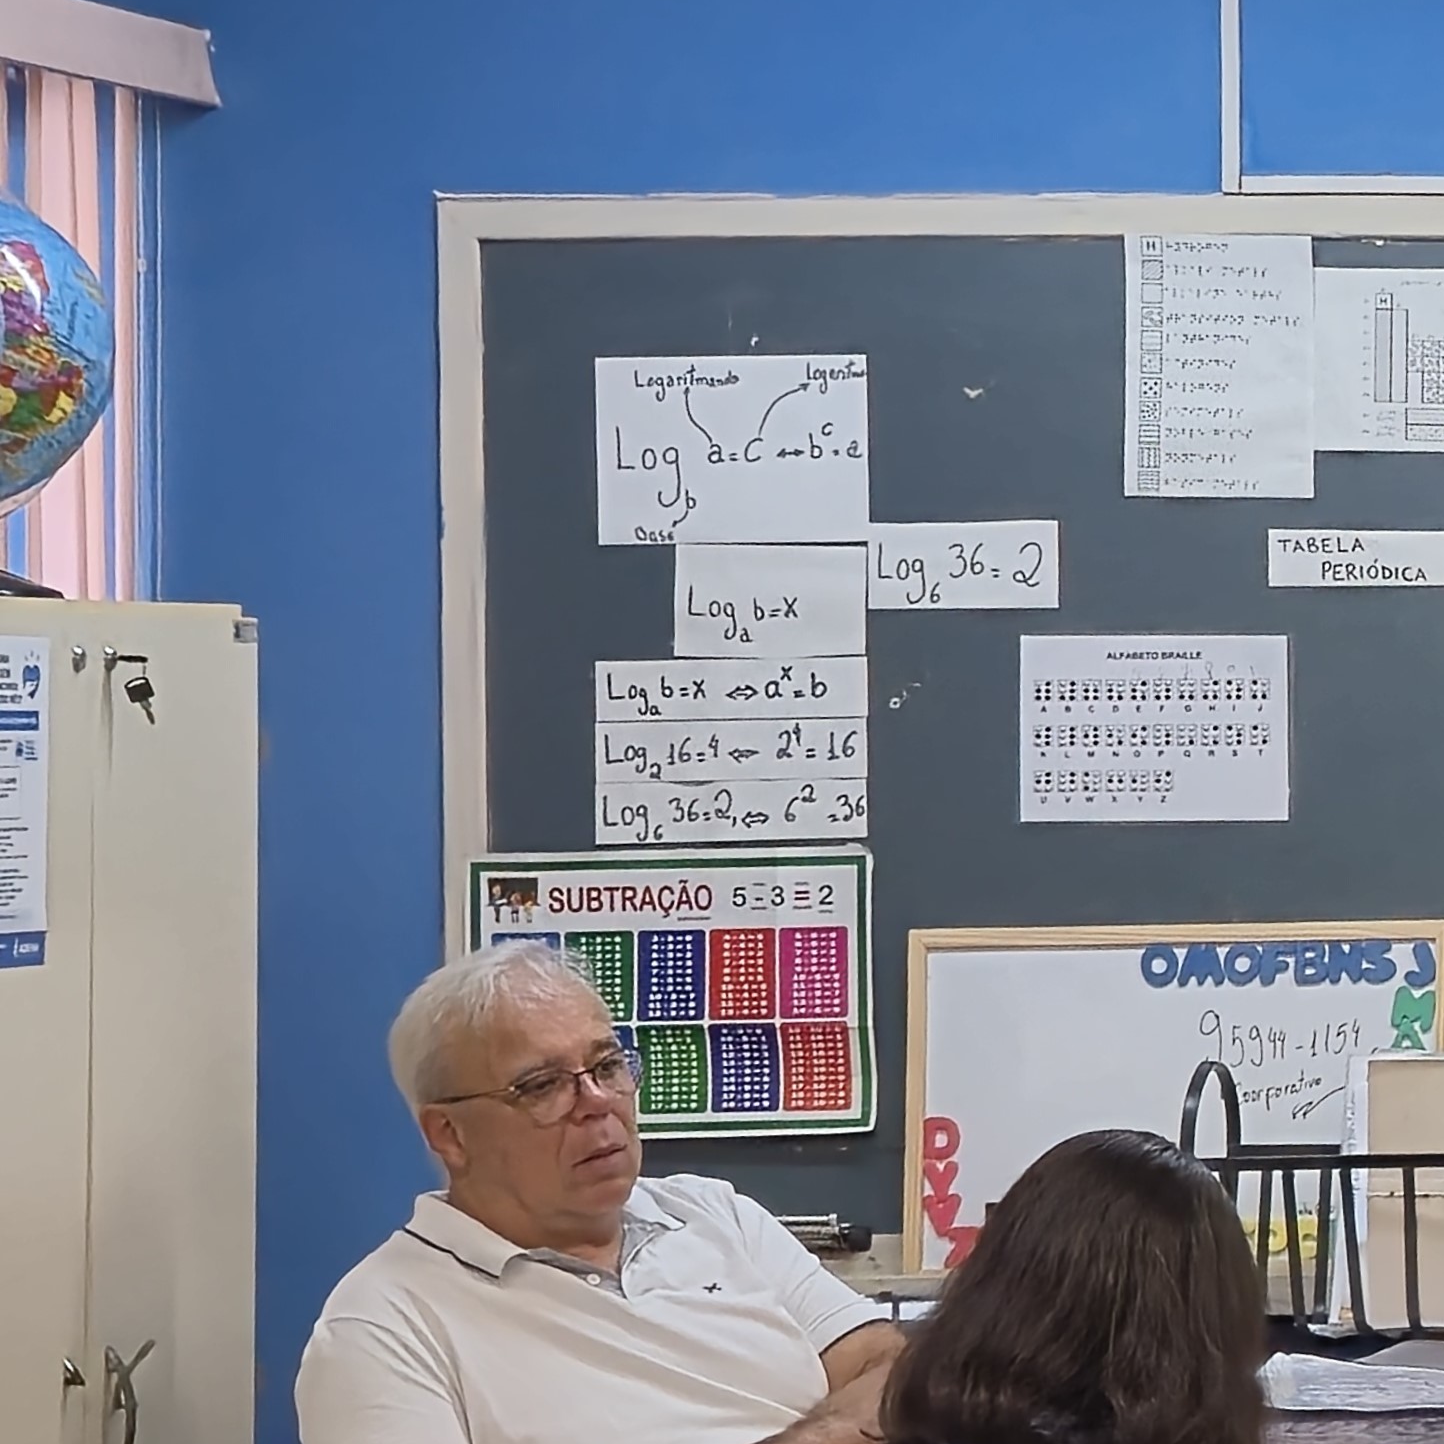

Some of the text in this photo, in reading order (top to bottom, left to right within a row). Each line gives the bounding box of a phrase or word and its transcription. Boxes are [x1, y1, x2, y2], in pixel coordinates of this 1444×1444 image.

[1277, 536, 1365, 554] TABELA
[1320, 557, 1428, 582] PERIÓDICA
[1106, 652, 1159, 660] ALFABETO
[548, 879, 713, 919] SUBTRAÇÃO
